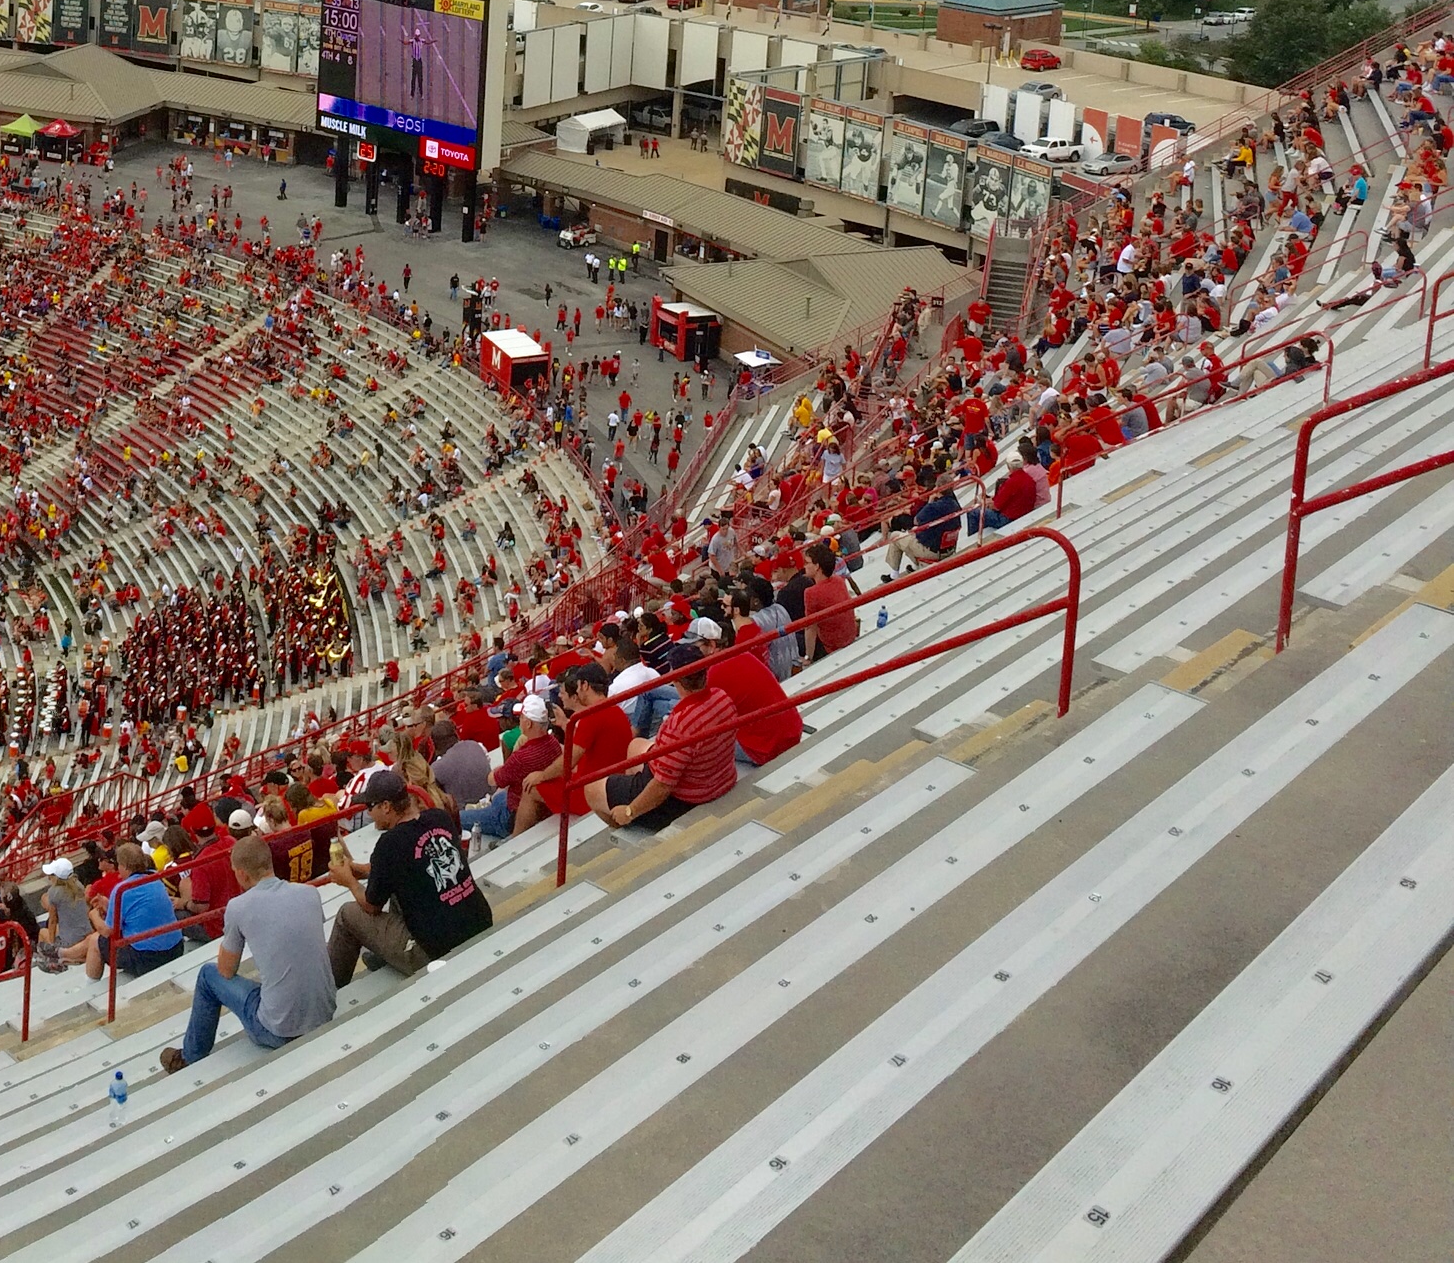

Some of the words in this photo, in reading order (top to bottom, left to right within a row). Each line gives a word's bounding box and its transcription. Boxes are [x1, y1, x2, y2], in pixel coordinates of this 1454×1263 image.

[452, 0, 481, 11] MARYLAND
[451, 7, 475, 17] LOTTERY
[139, 6, 167, 37] M
[324, 10, 357, 30] 15:00
[224, 47, 246, 64] 28
[321, 116, 347, 133] MUSCLE
[348, 121, 367, 138] MILK
[765, 113, 795, 156] M
[360, 143, 372, 159] 25
[441, 147, 469, 162] TOYOTA
[492, 346, 502, 370] M
[1089, 894, 1102, 903] 19
[865, 914, 879, 924] 20
[628, 979, 642, 988] 20
[778, 979, 791, 988] 19
[1315, 972, 1333, 985] 17
[512, 988, 524, 996] 21
[427, 1043, 440, 1052] 20
[539, 1043, 551, 1051] 19
[676, 1054, 691, 1064] 18
[891, 1056, 907, 1068] 17
[1212, 1078, 1232, 1092] 16
[256, 1089, 268, 1098] 20
[436, 1112, 450, 1121] 18
[566, 1135, 579, 1146] 17
[769, 1158, 787, 1171] 16
[329, 1186, 341, 1196] 17
[1088, 1209, 1110, 1226] 15
[440, 1229, 456, 1241] 16
